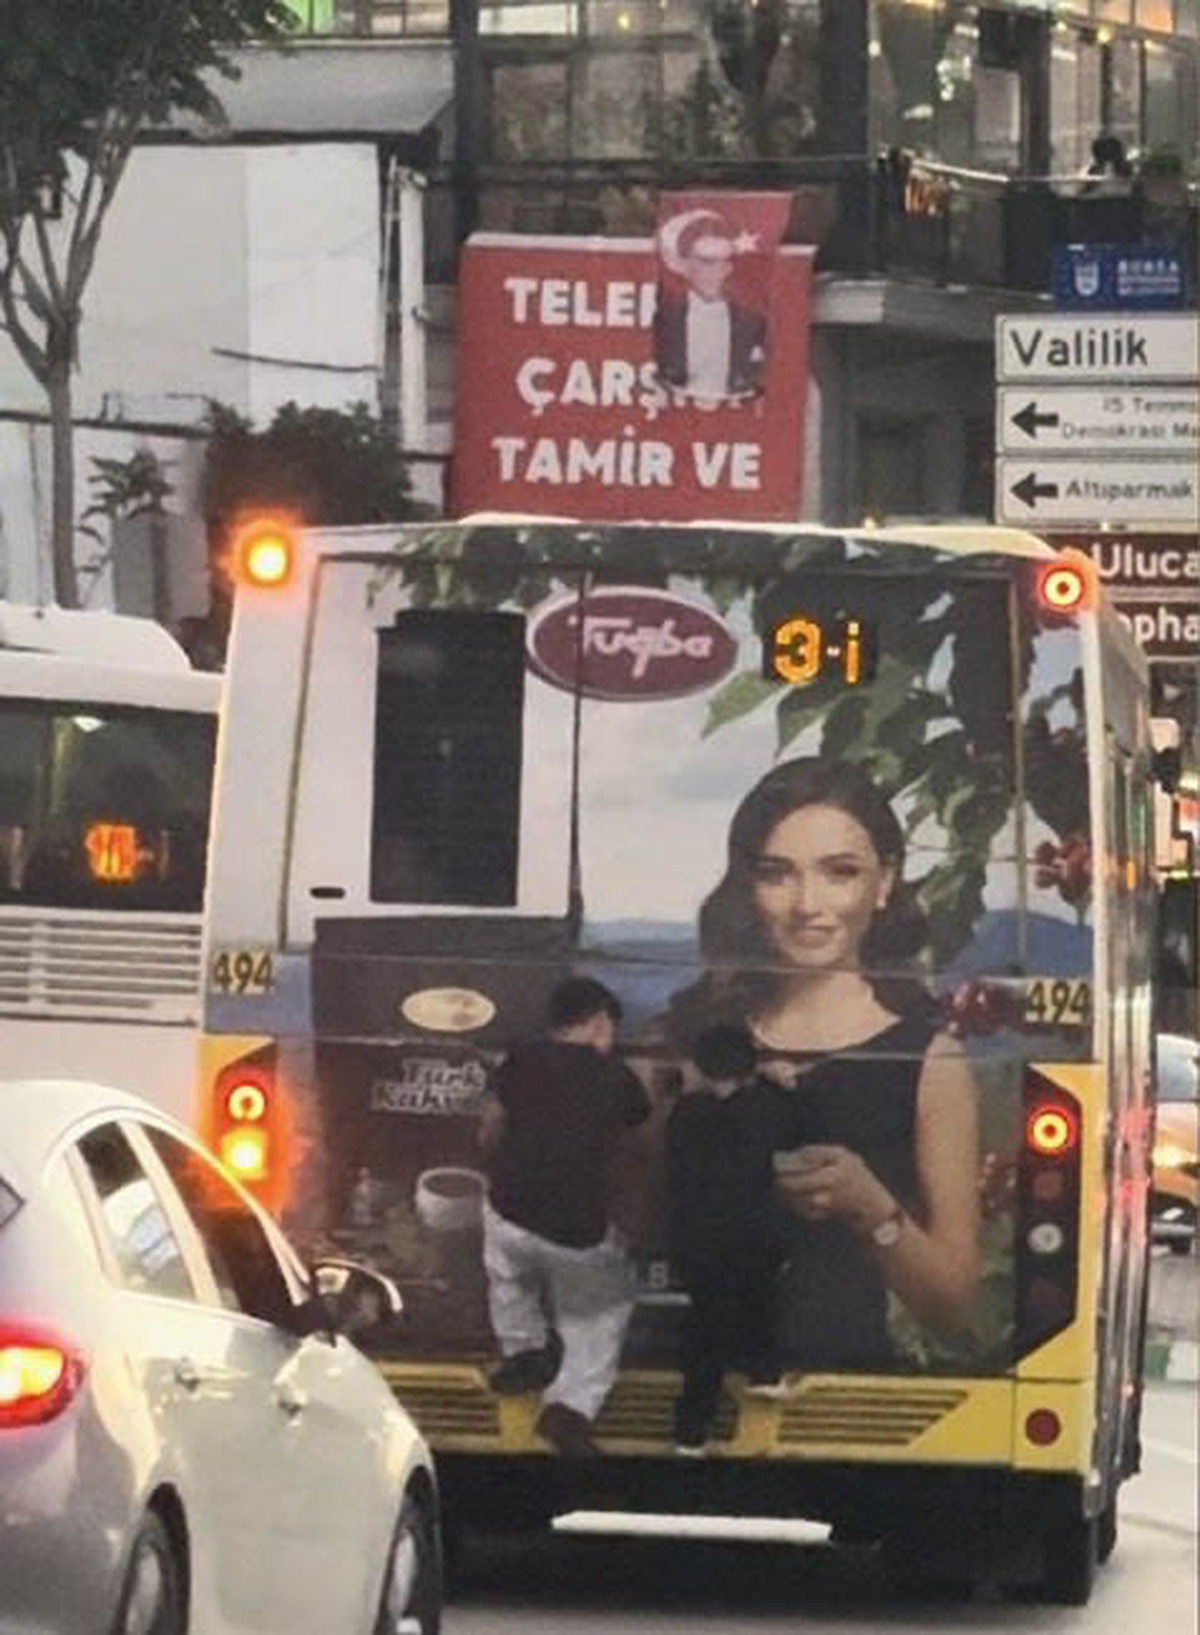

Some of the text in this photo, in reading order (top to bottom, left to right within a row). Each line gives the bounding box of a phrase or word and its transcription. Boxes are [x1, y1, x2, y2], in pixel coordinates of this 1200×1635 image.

[1010, 328, 1148, 366] Valilik
[491, 424, 762, 489] TAMİR VE
[214, 952, 276, 996] 494
[1026, 982, 1091, 1022] 494
